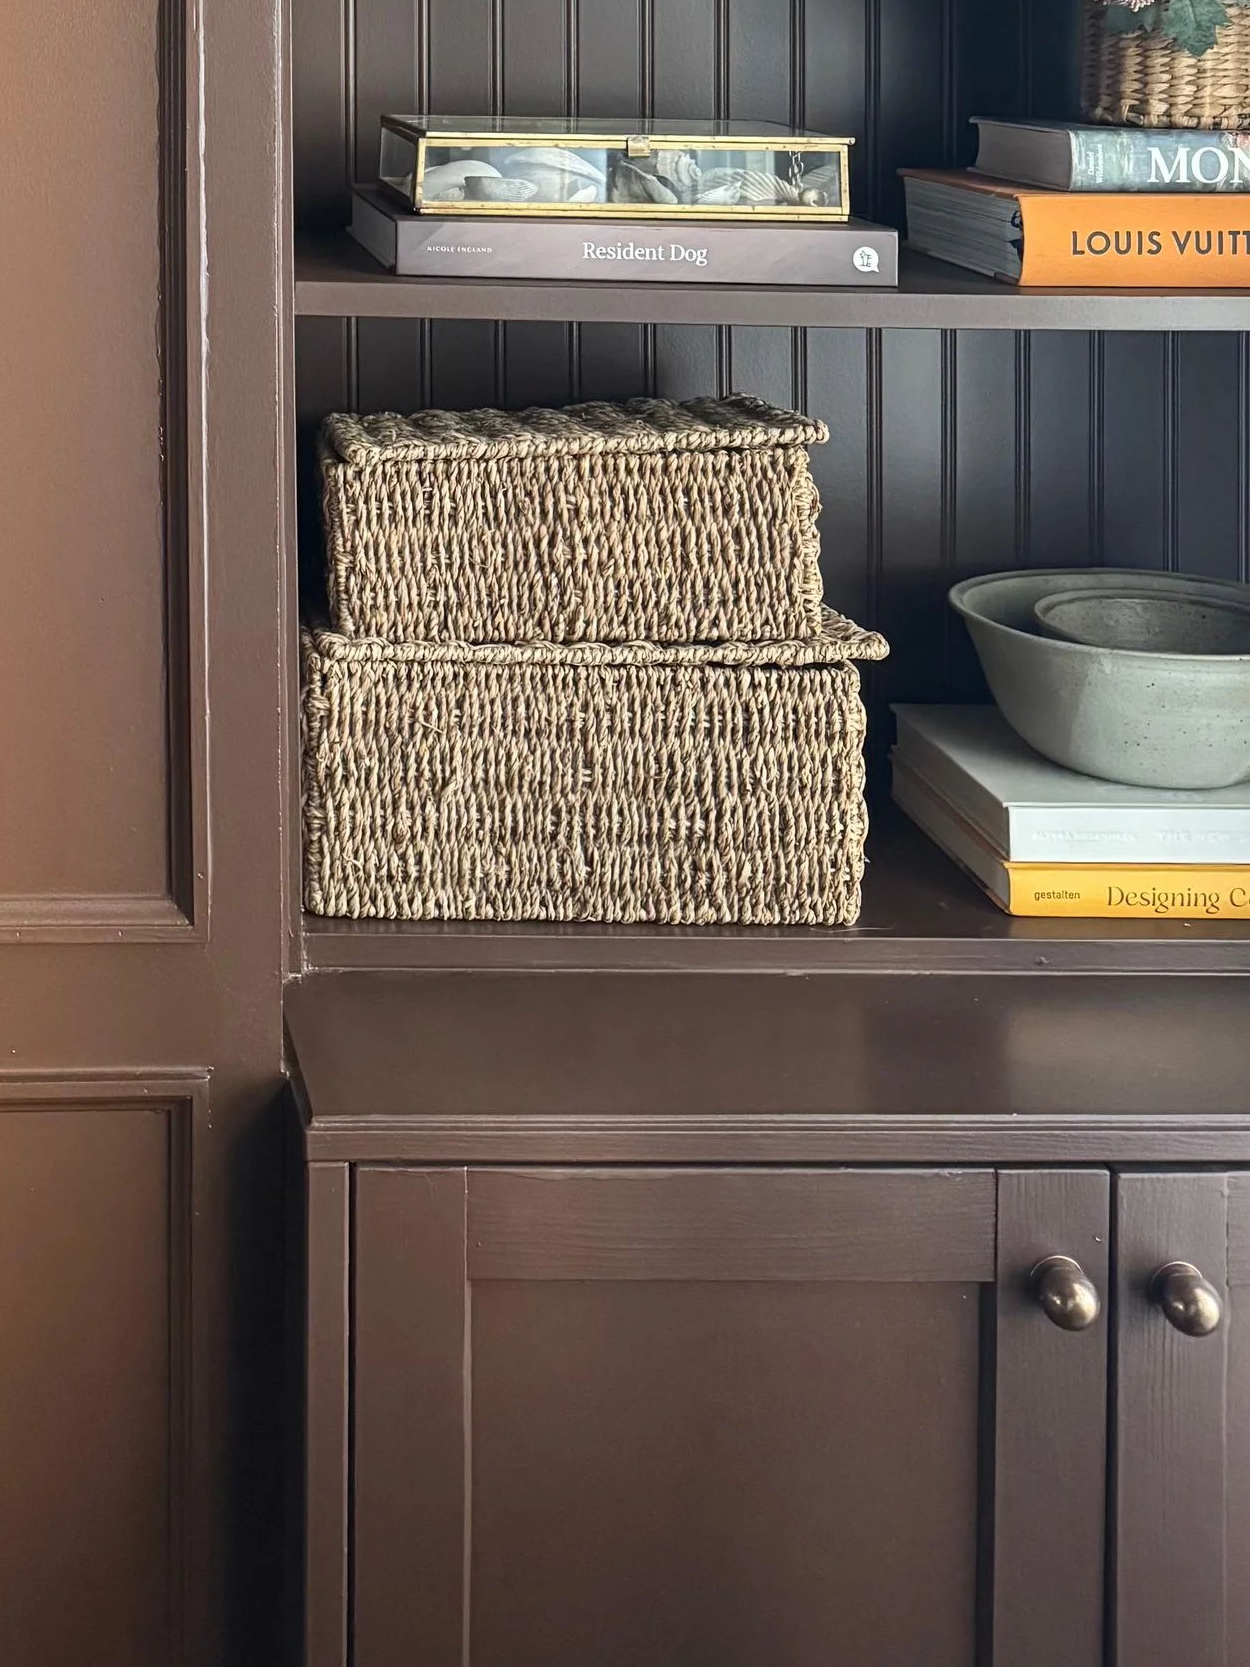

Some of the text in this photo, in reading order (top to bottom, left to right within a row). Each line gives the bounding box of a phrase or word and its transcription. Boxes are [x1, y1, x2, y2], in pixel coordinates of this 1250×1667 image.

[426, 245, 494, 254] NICOLE ENGLAND
[582, 241, 709, 267] Resident Dog
[1071, 230, 1163, 256] LOUIS
[1034, 885, 1250, 914] gestalten Designing C
